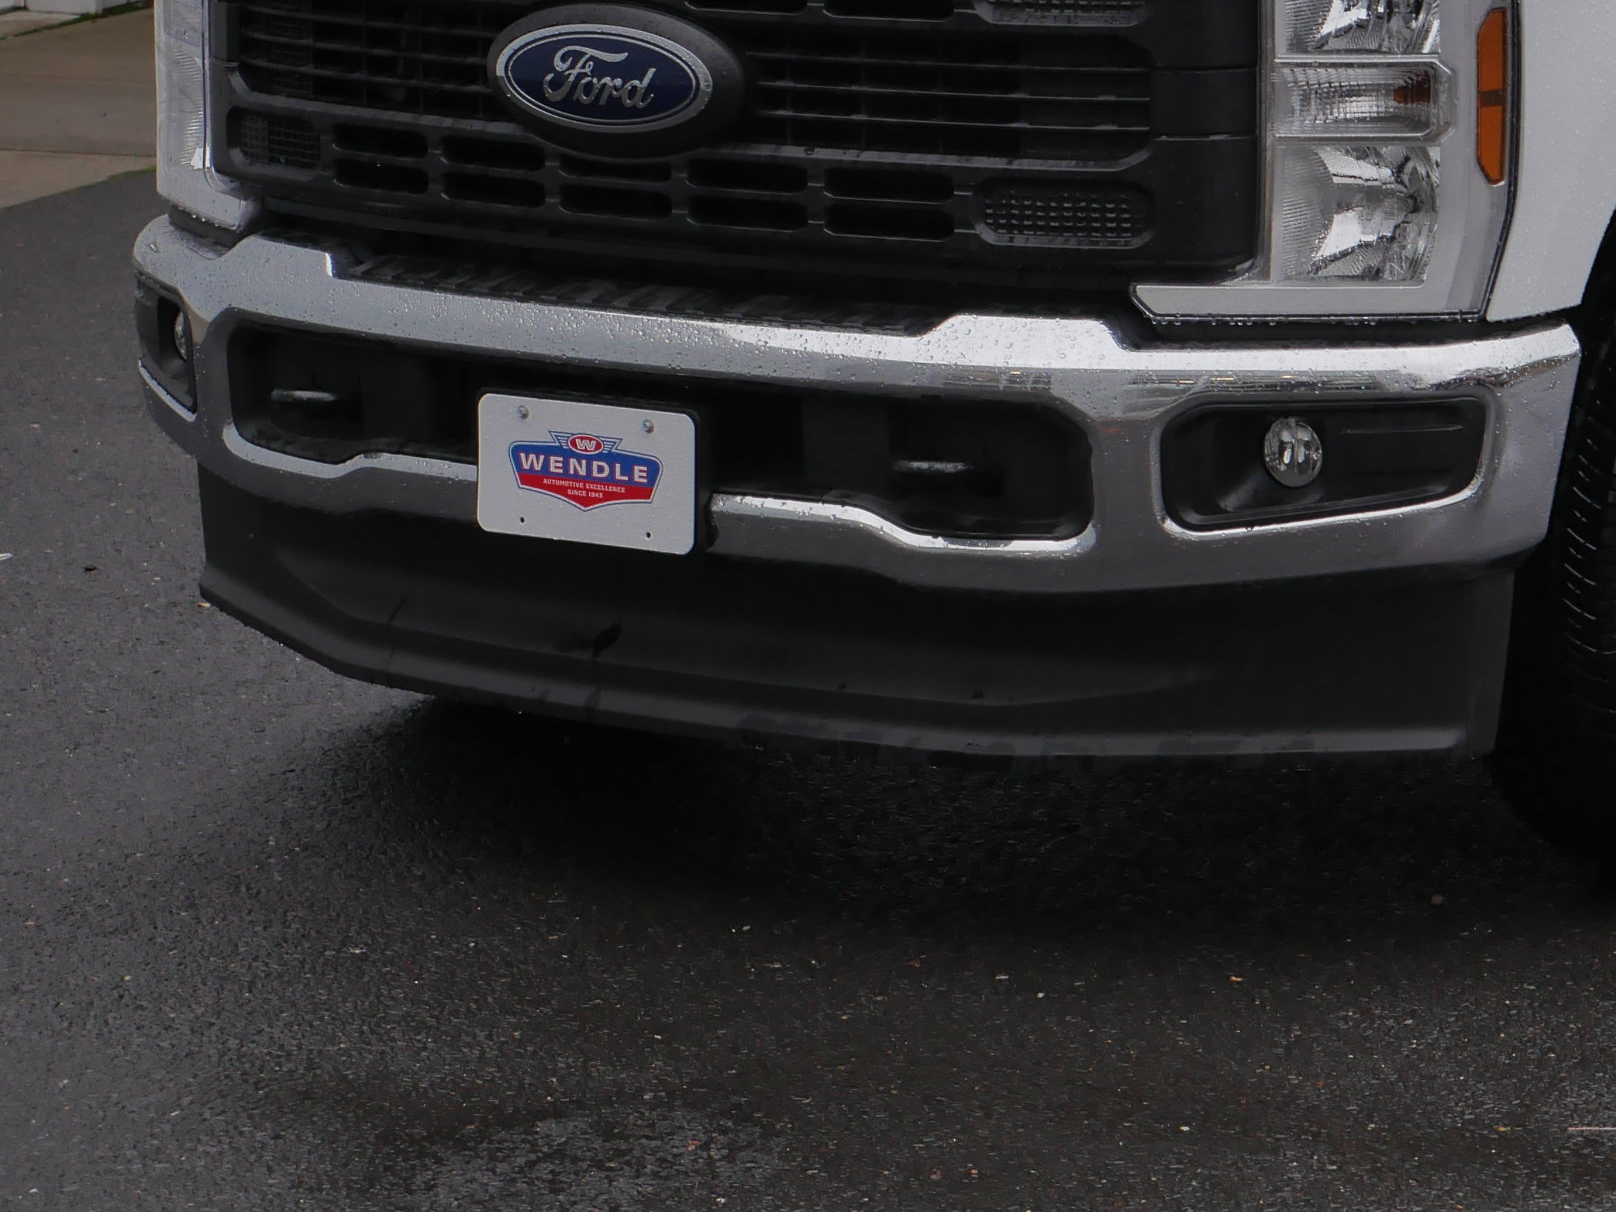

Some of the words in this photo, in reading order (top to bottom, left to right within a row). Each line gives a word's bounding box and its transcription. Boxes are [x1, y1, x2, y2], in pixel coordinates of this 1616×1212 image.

[543, 45, 657, 109] Ford
[519, 452, 649, 484] WENDLE
[585, 482, 626, 493] EXCELLENCE
